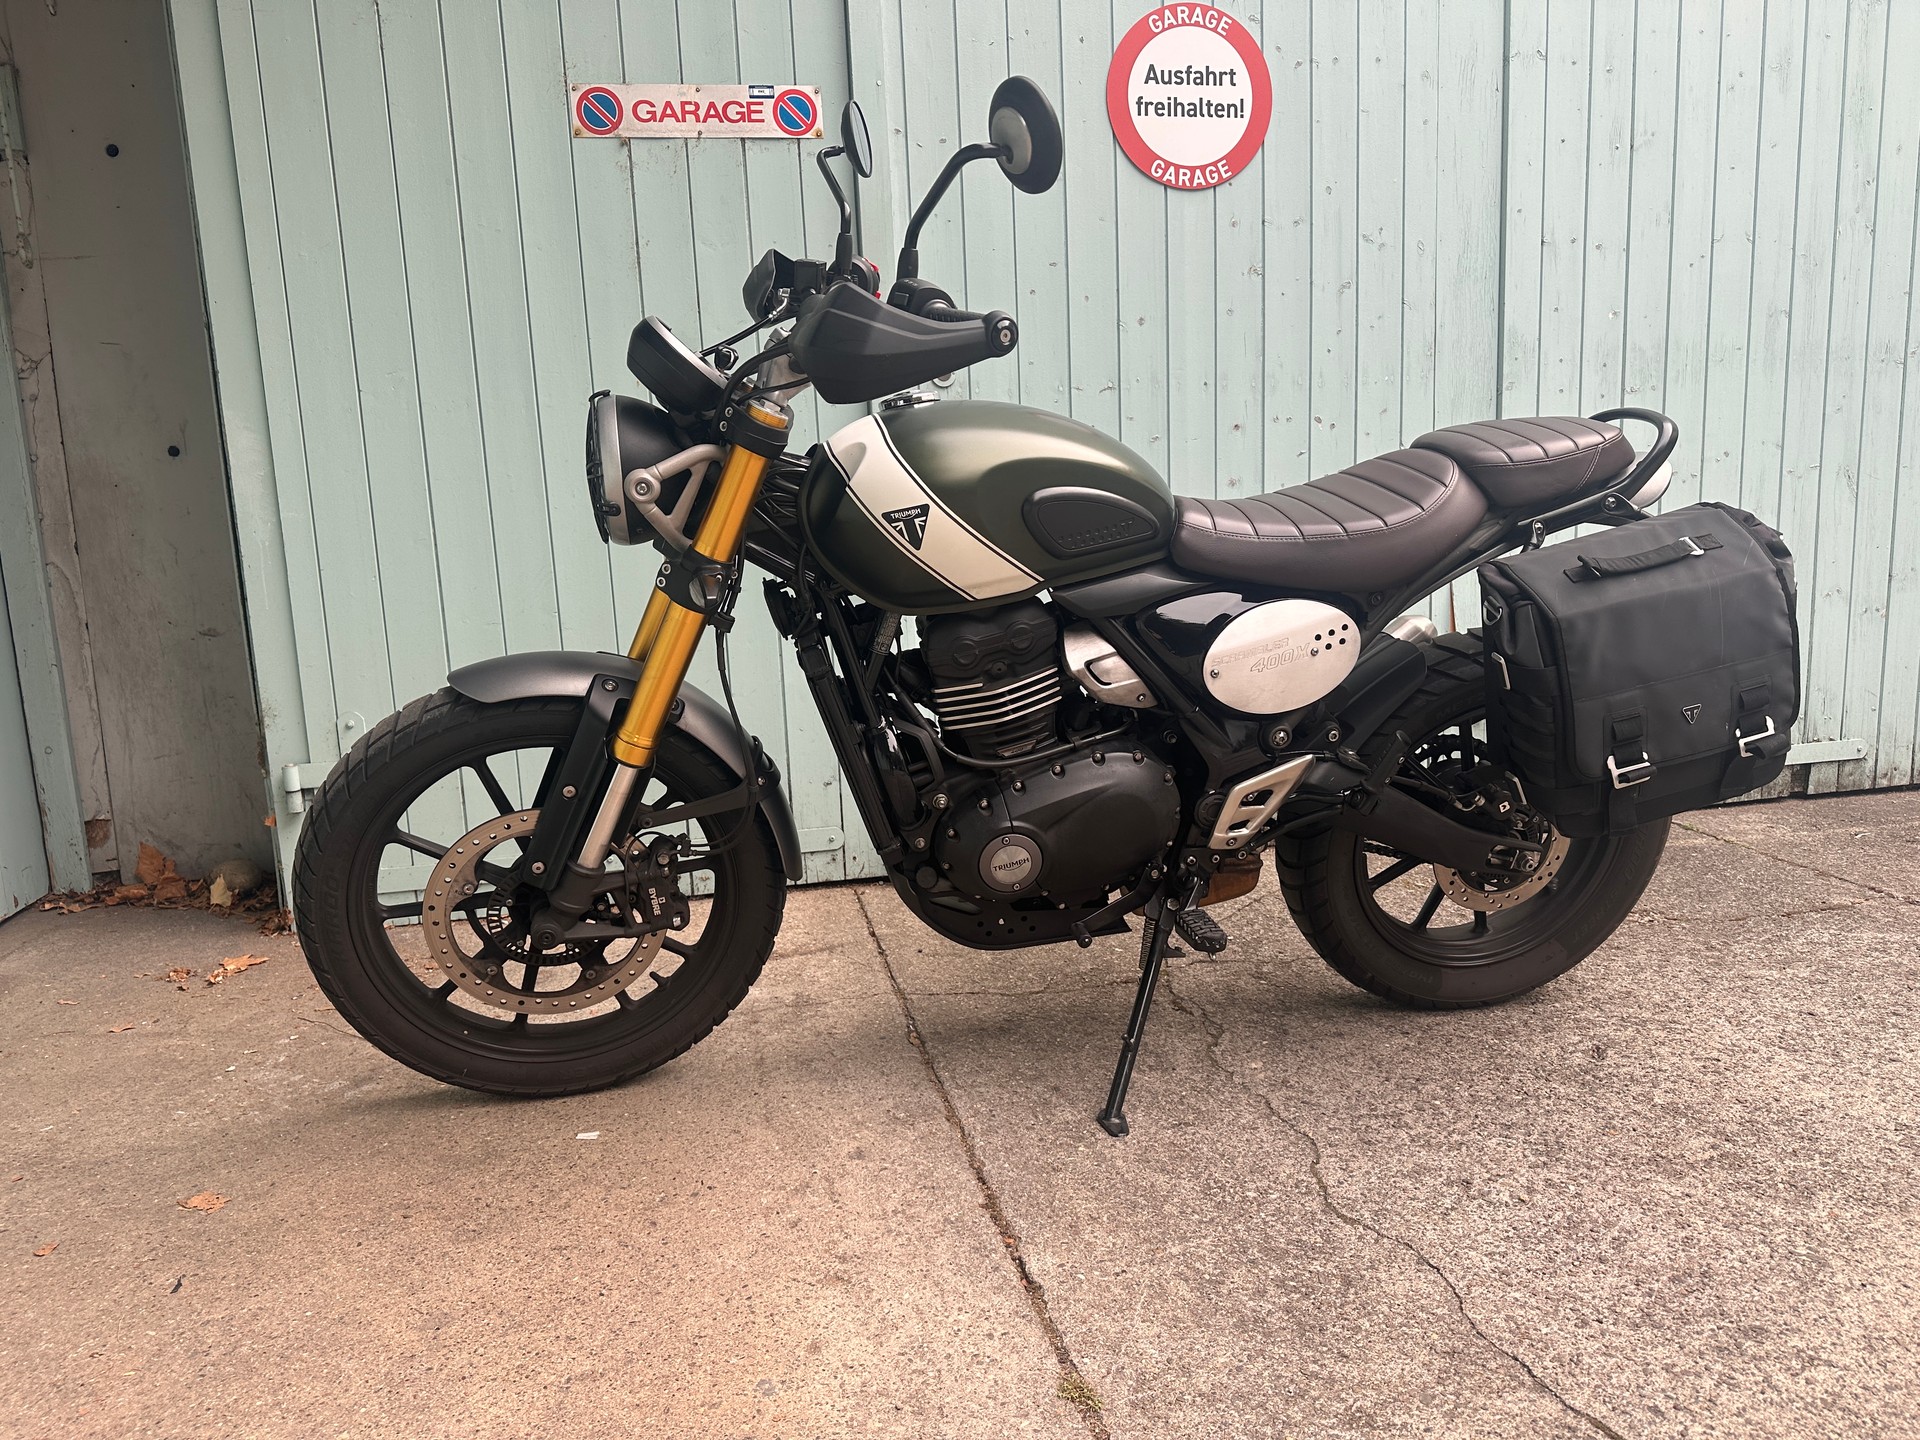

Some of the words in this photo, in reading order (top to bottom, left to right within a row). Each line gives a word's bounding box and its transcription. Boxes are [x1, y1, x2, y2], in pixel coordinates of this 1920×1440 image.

[1148, 6, 1233, 36] GARAGE
[1144, 64, 1237, 87] Ausfahrt
[631, 100, 766, 124] GARAGE
[1136, 96, 1245, 119] freihalten!
[1150, 159, 1233, 187] GARAGE
[890, 508, 922, 520] TRIUMPH
[1250, 642, 1311, 673] 400X
[993, 857, 1030, 872] TRIUMPH
